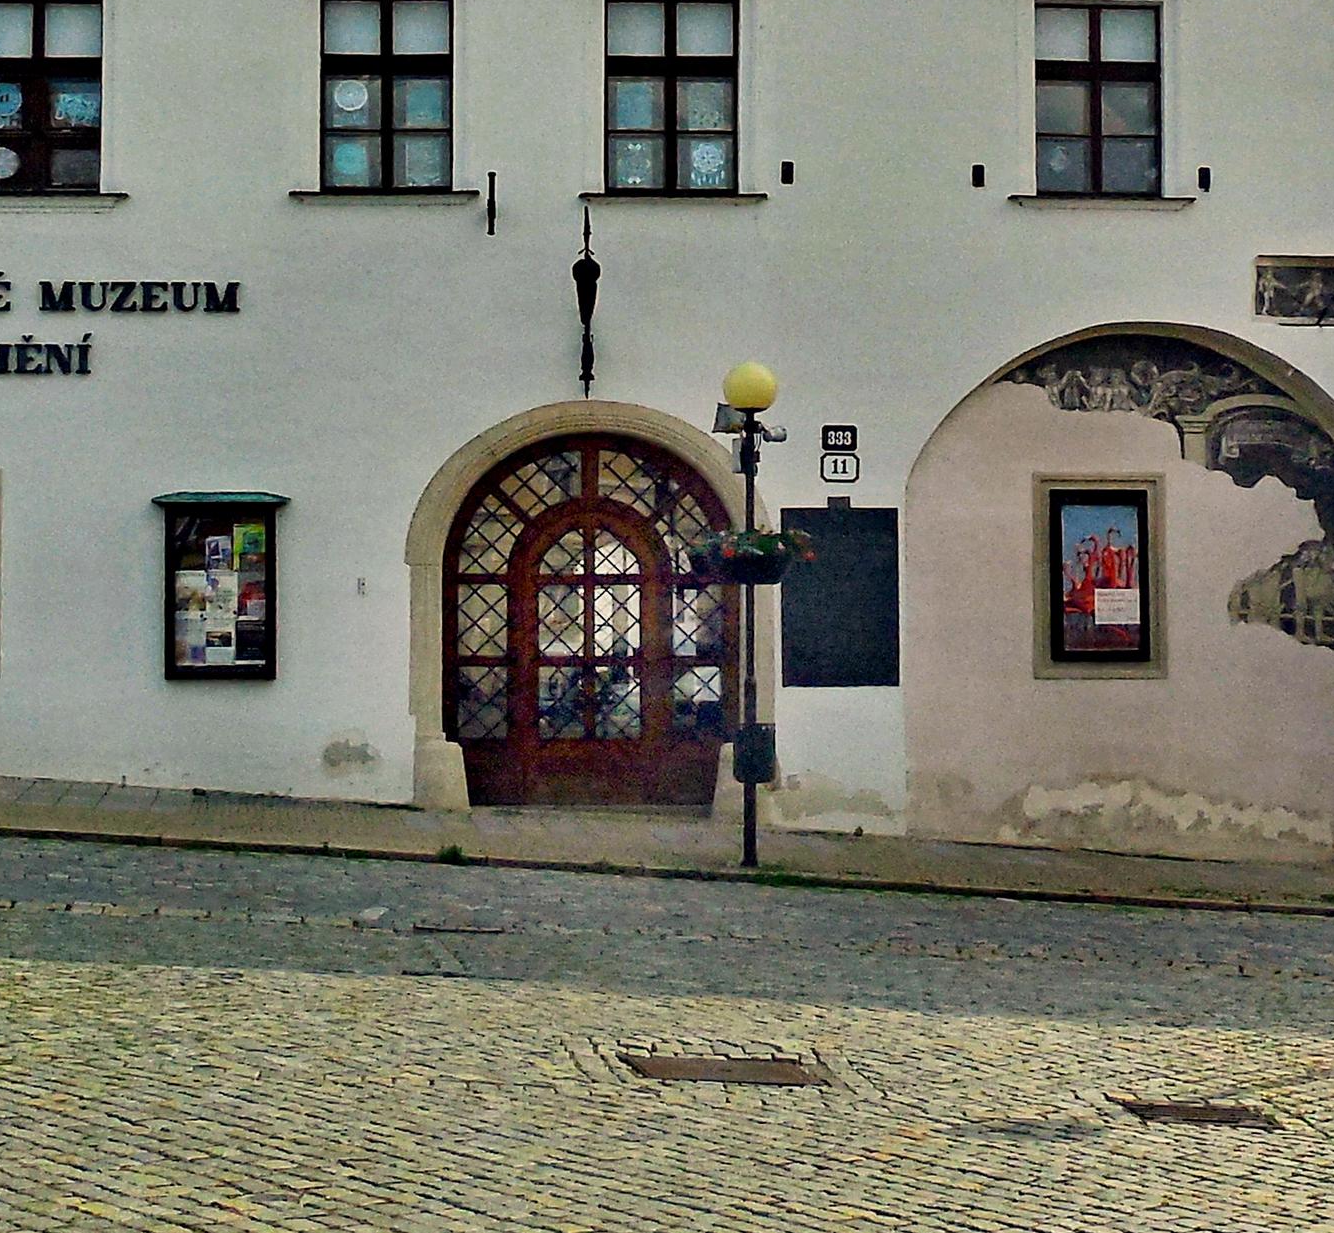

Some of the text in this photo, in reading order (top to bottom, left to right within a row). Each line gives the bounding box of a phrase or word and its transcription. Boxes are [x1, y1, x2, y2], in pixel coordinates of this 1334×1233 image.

[38, 279, 242, 313] MUZEUM
[827, 430, 853, 446] 333
[831, 457, 849, 475] 11
